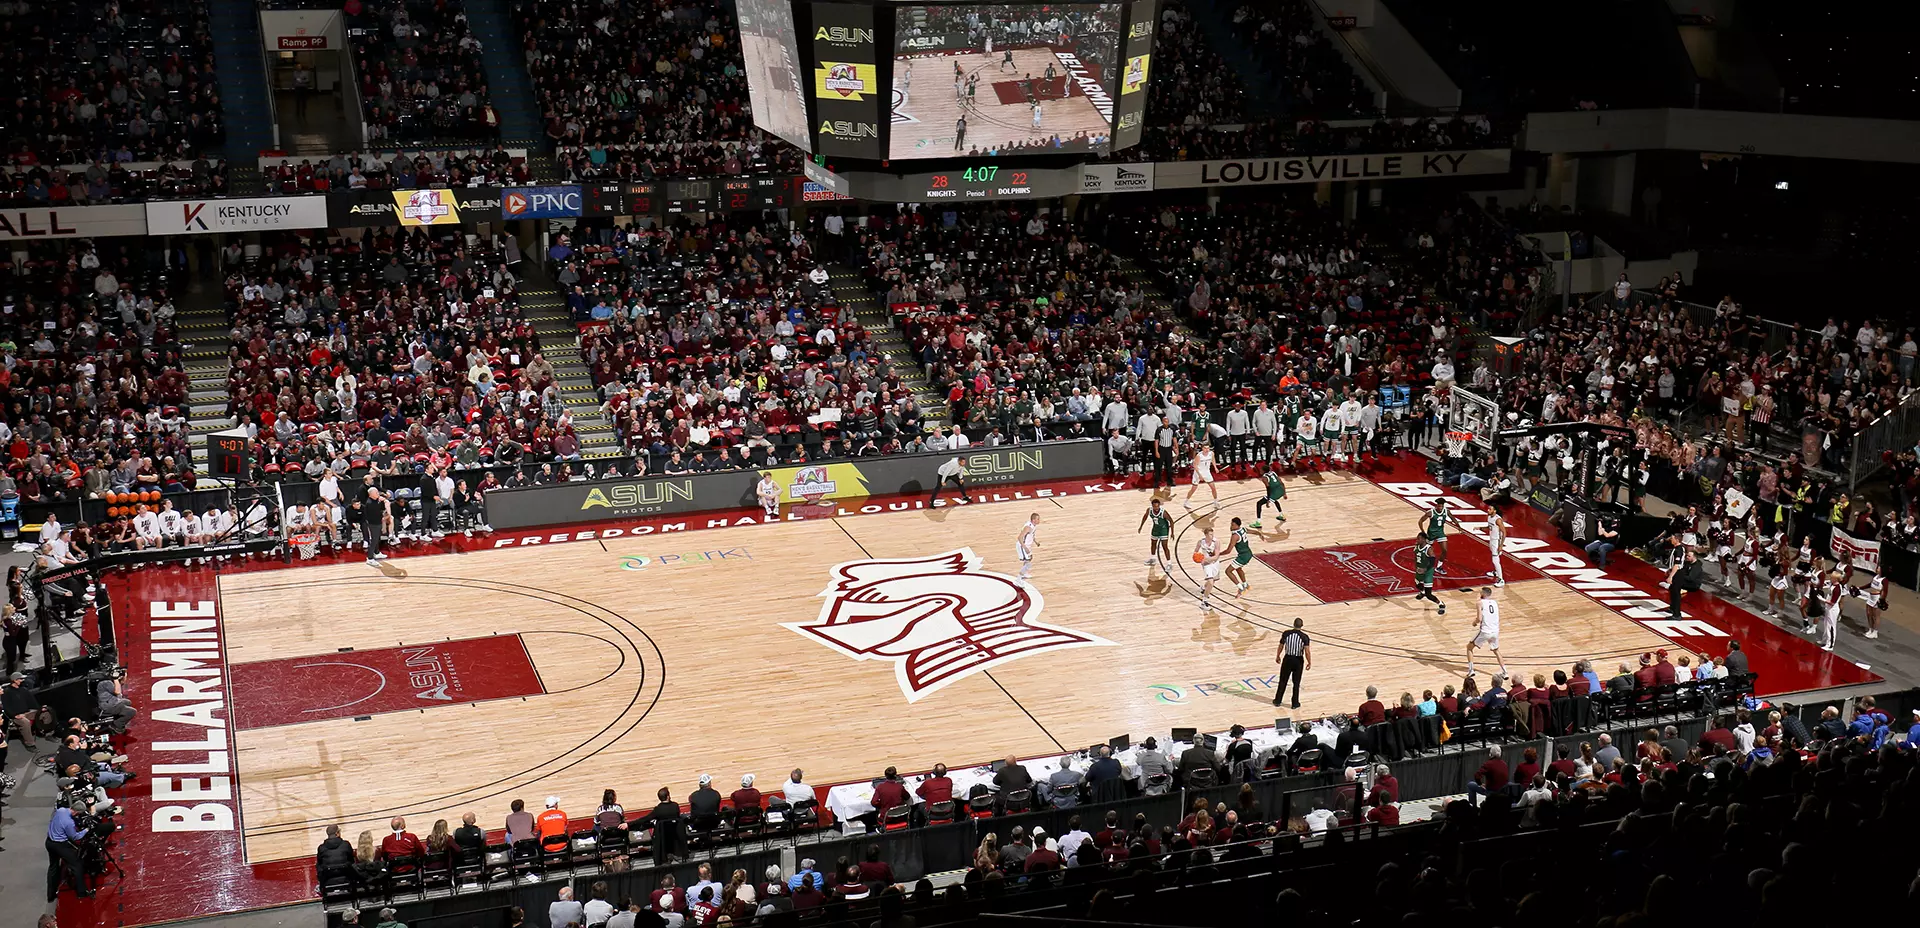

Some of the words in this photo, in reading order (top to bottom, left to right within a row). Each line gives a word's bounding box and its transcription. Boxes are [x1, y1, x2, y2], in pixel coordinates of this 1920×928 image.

[282, 39, 307, 47] Ramp
[815, 27, 873, 43] ASUN
[819, 121, 877, 137] ASUN
[963, 166, 998, 182] 4:07
[1201, 156, 1402, 184] LOUISVILLE
[1422, 153, 1467, 175] KY
[932, 176, 948, 188] 28
[1012, 173, 1027, 184] 22
[803, 192, 835, 201] STATE
[998, 187, 1031, 195] DOLPHINS
[350, 203, 392, 213] ASUN
[460, 200, 500, 209] ASUN
[532, 192, 580, 212] PNC
[731, 194, 748, 208] 22
[219, 204, 291, 218] KENTUCKY
[219, 218, 280, 226] VENUES
[220, 440, 244, 451] 4:07
[224, 454, 241, 474] 17
[962, 450, 1043, 476] SUN
[972, 474, 1015, 483] PHOTOS
[580, 480, 693, 510] ASUN
[494, 522, 686, 549] FREEDOM
[707, 513, 804, 528] HALL
[1085, 482, 1126, 493] KY
[613, 506, 662, 515] PHOTOS
[42, 572, 72, 584] FREEDOM
[73, 567, 89, 575] HALL
[1324, 551, 1415, 593] ASUN
[402, 647, 452, 700] ASUN
[443, 652, 463, 692] CONFERENCE
[151, 601, 234, 832] BELLARMINE
